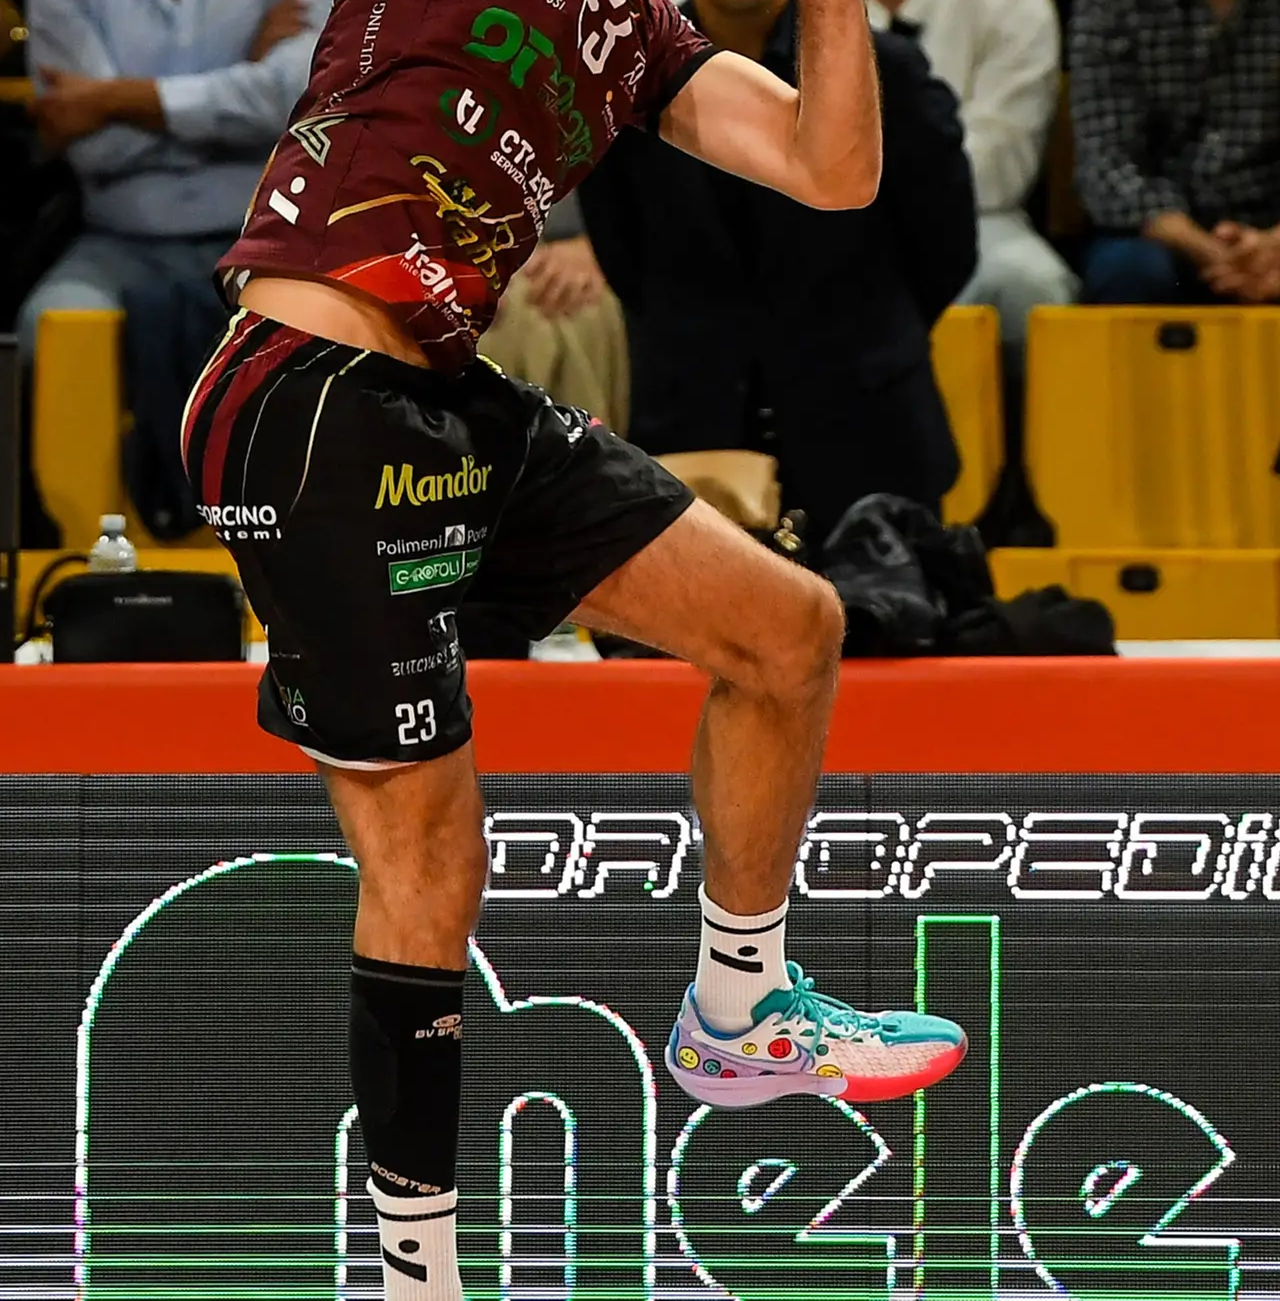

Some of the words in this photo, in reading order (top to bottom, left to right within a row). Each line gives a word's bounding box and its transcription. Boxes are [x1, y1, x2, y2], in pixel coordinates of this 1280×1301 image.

[376, 534, 443, 556] Polimeni
[395, 699, 437, 746] 23
[370, 1160, 442, 1195] BOOSTER
